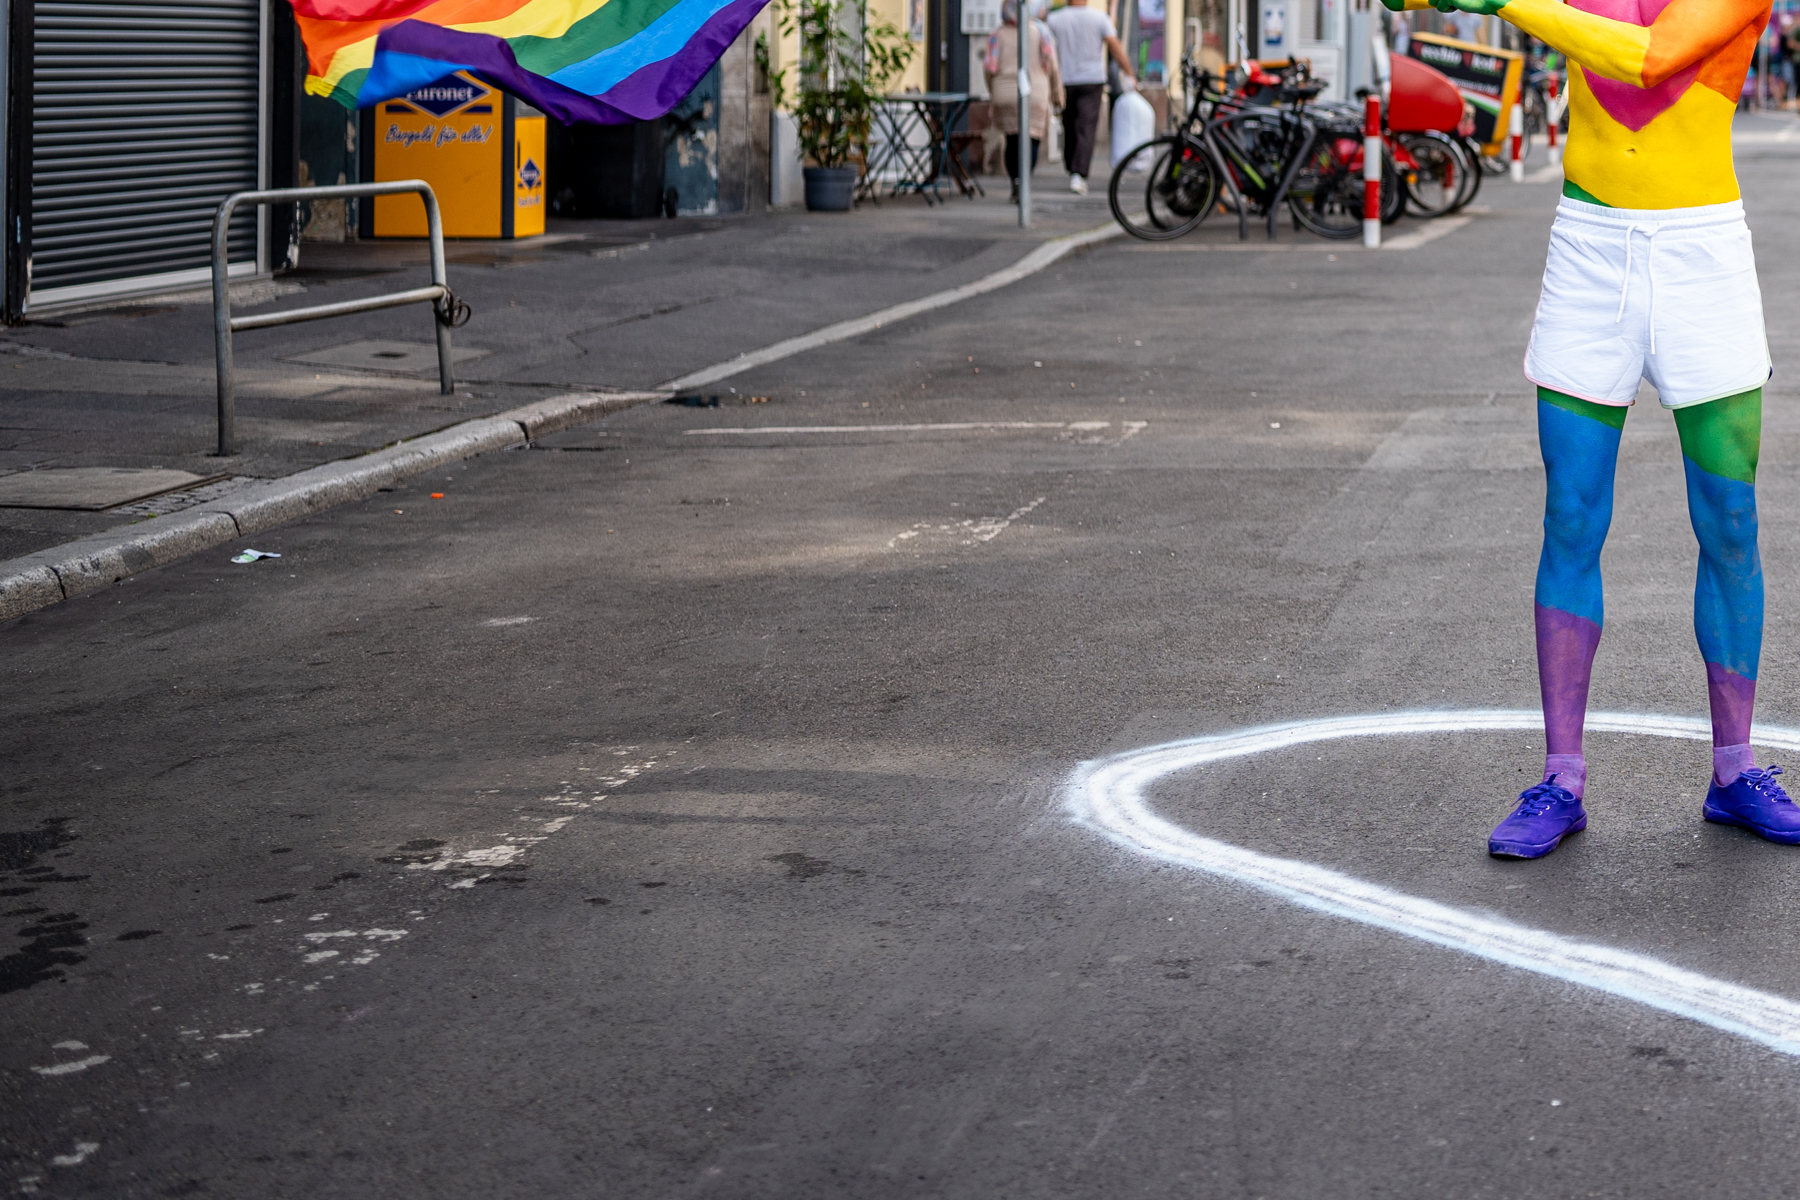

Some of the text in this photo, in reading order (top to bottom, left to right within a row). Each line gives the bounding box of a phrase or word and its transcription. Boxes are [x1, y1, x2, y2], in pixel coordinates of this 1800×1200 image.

[385, 123, 494, 149] Bargeld für alle!
